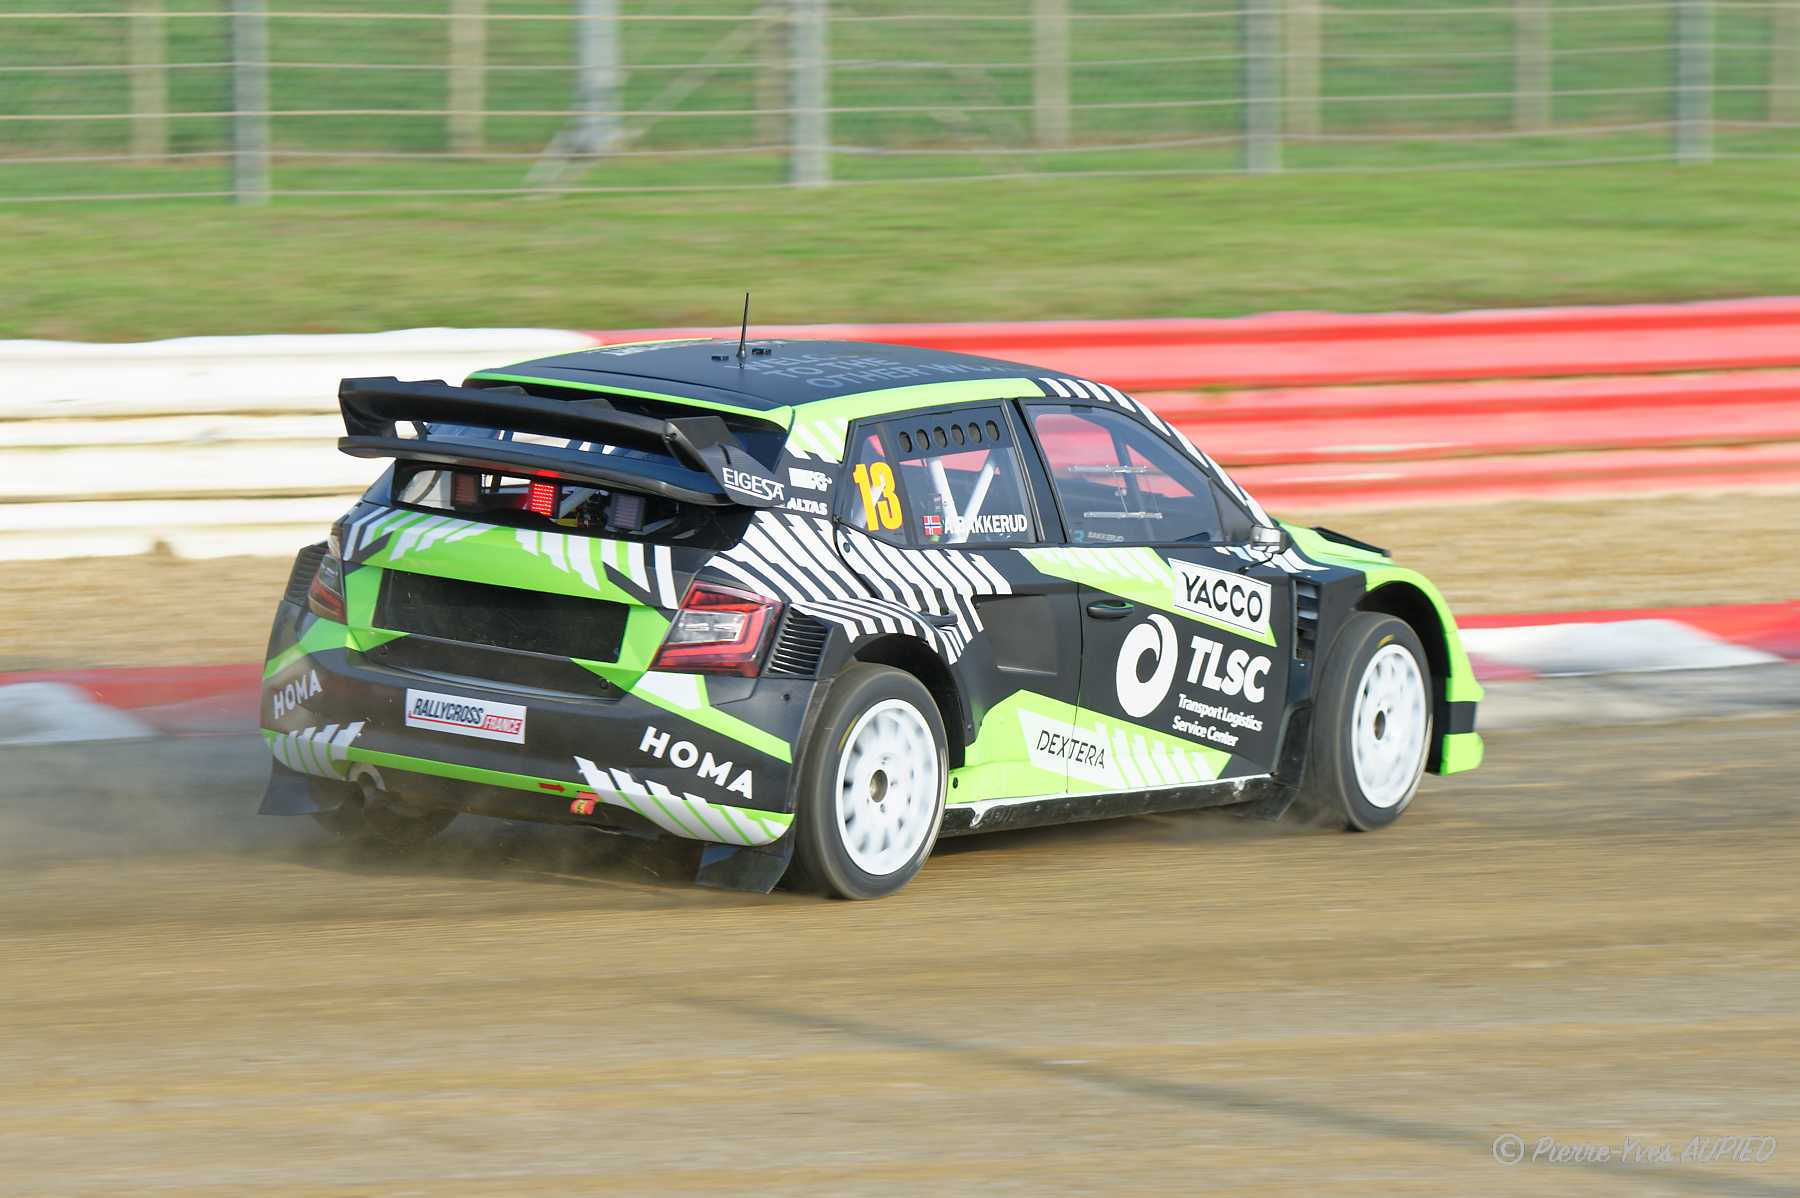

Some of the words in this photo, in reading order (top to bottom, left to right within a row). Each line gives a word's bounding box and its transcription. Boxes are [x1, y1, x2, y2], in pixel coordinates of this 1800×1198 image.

[762, 366, 825, 379] TO
[816, 357, 901, 370] THE
[805, 365, 932, 389] OTHER
[722, 467, 785, 501] EIGESA
[853, 462, 903, 532] 13
[1181, 571, 1263, 623] YACCO
[1186, 635, 1272, 704] TLSC
[273, 669, 323, 720] HOMA
[1178, 693, 1223, 720] Transport
[1221, 706, 1264, 732] Logistics
[413, 697, 484, 725] RALLYCROSS
[485, 715, 521, 735] FRANCE
[1172, 715, 1207, 738] Service
[1207, 725, 1240, 747] Center
[639, 725, 753, 800] HOMA
[1036, 729, 1105, 769] DEXTERA
